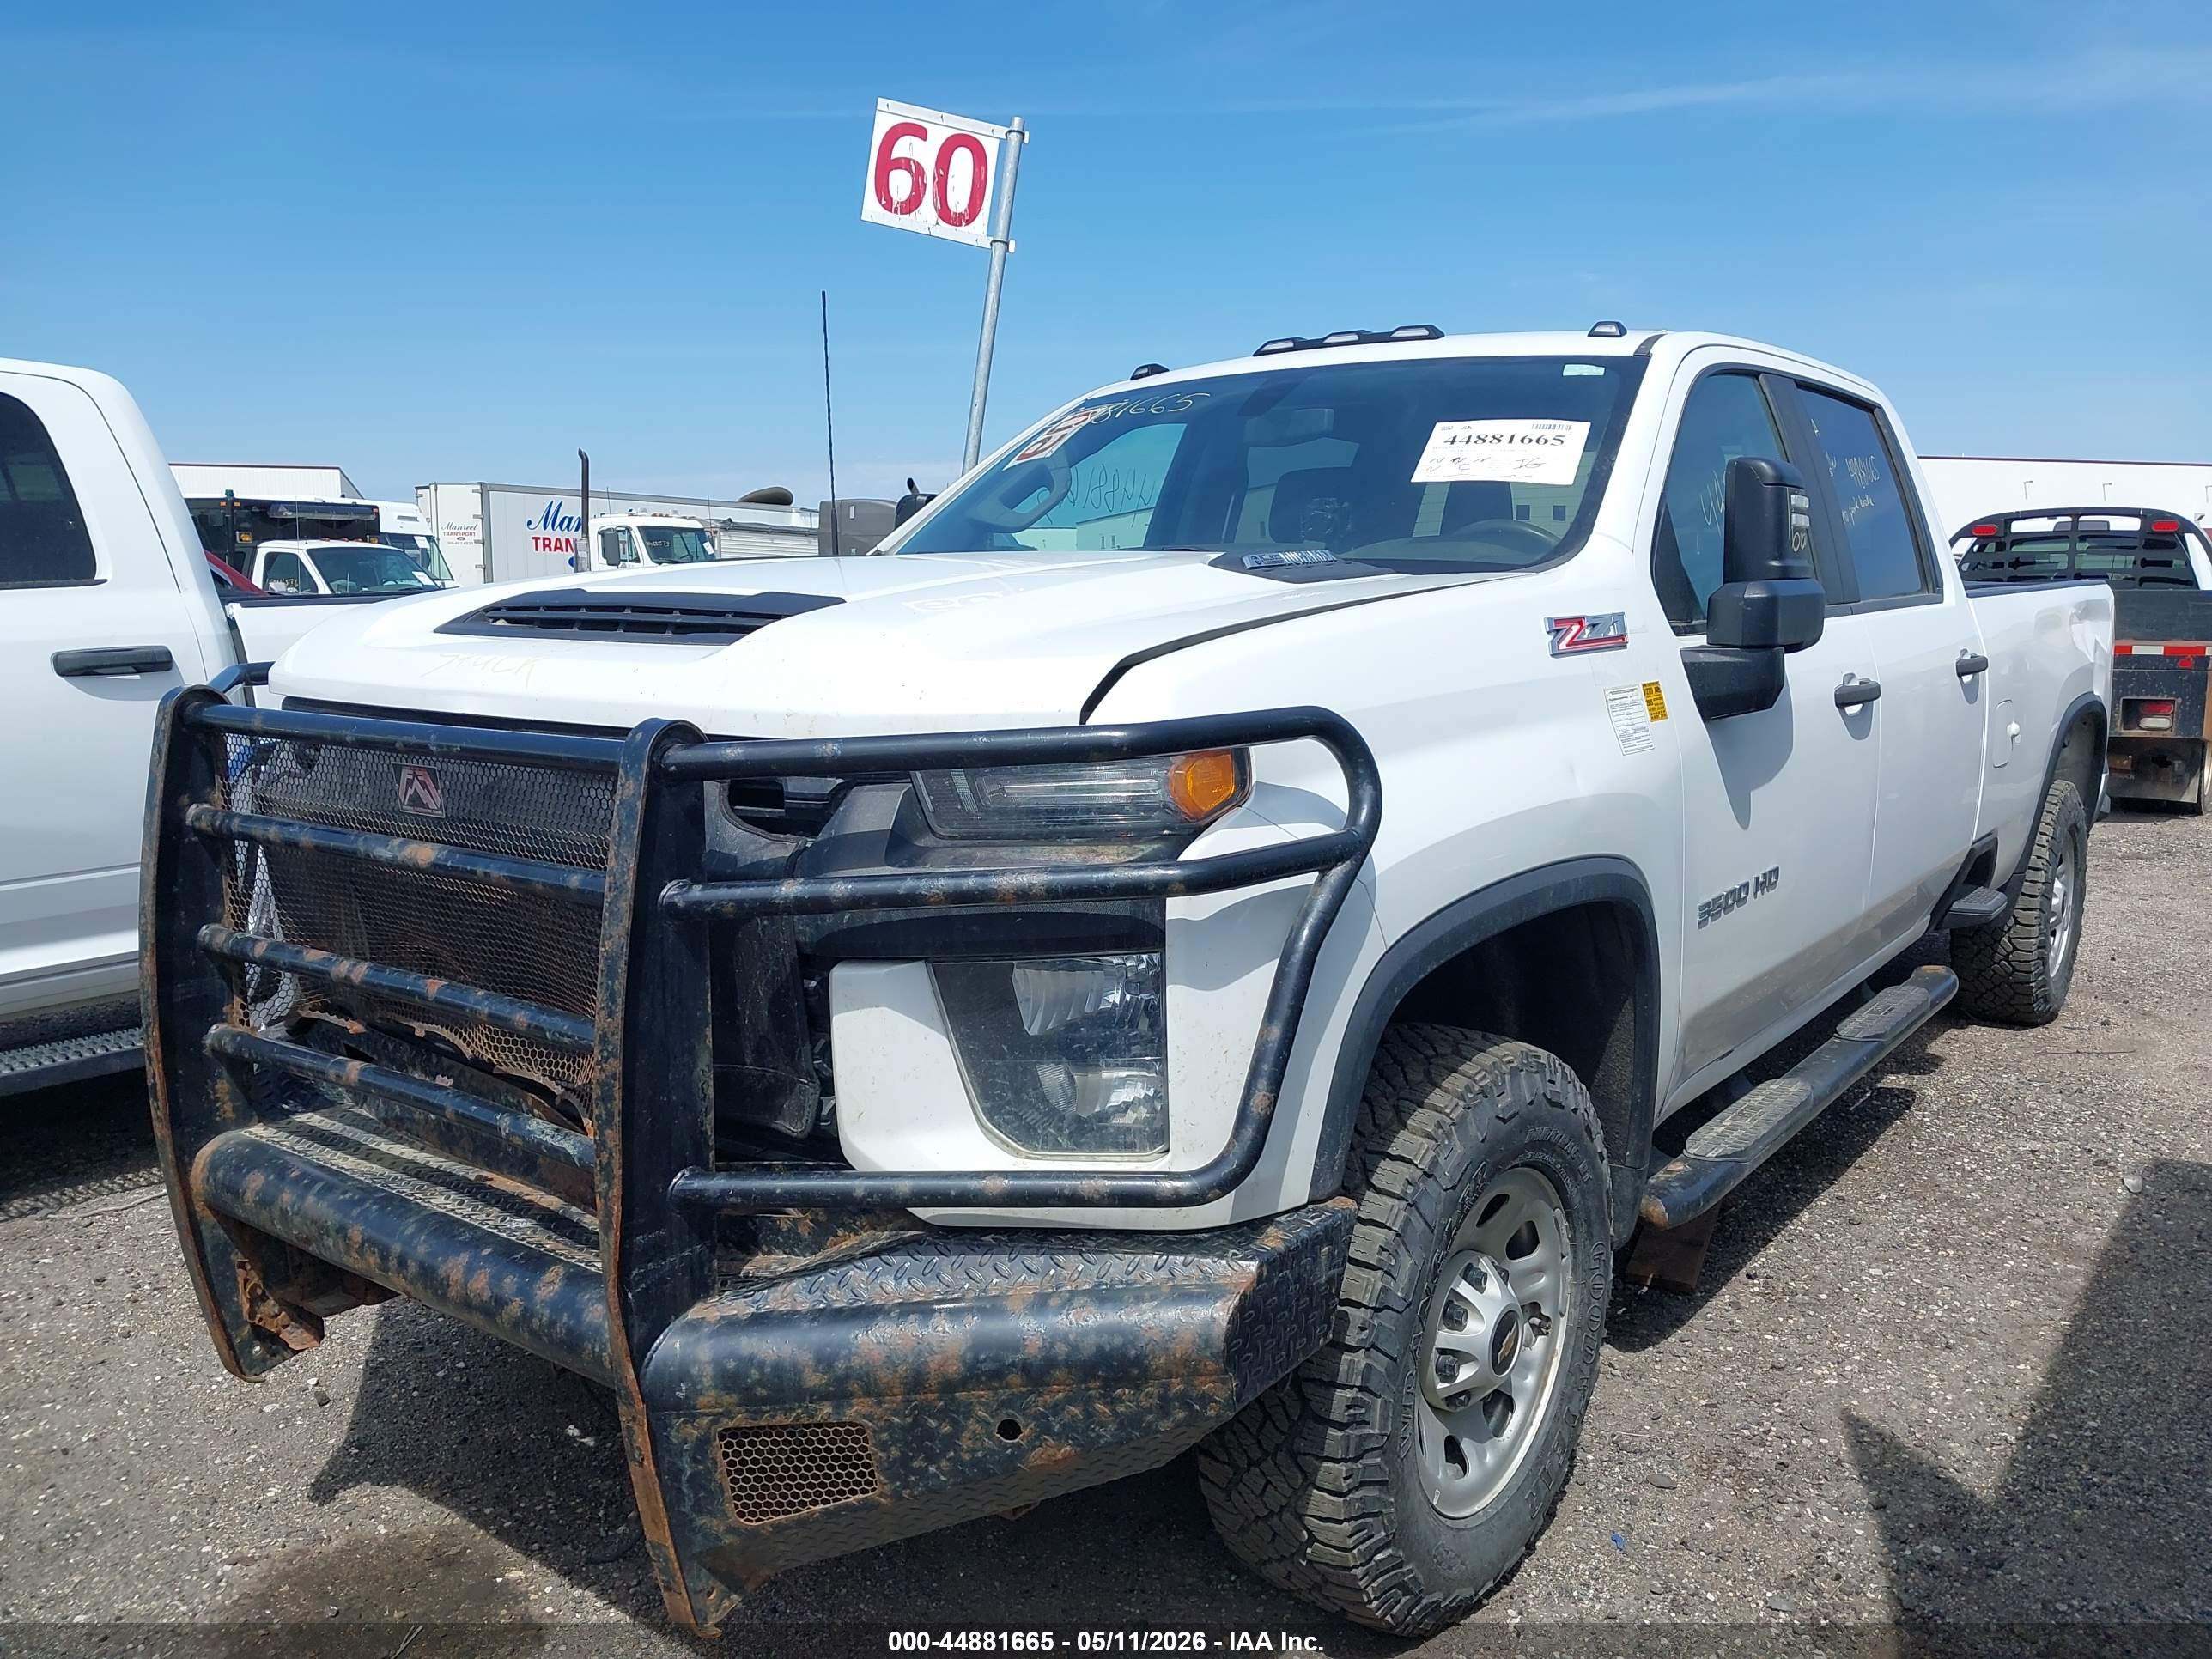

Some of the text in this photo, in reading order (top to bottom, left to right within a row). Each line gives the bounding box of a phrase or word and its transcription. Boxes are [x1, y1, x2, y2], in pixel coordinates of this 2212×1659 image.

[874, 122, 988, 227] 60
[1443, 433, 1566, 447] 44881665
[1753, 866, 1780, 900] HD
